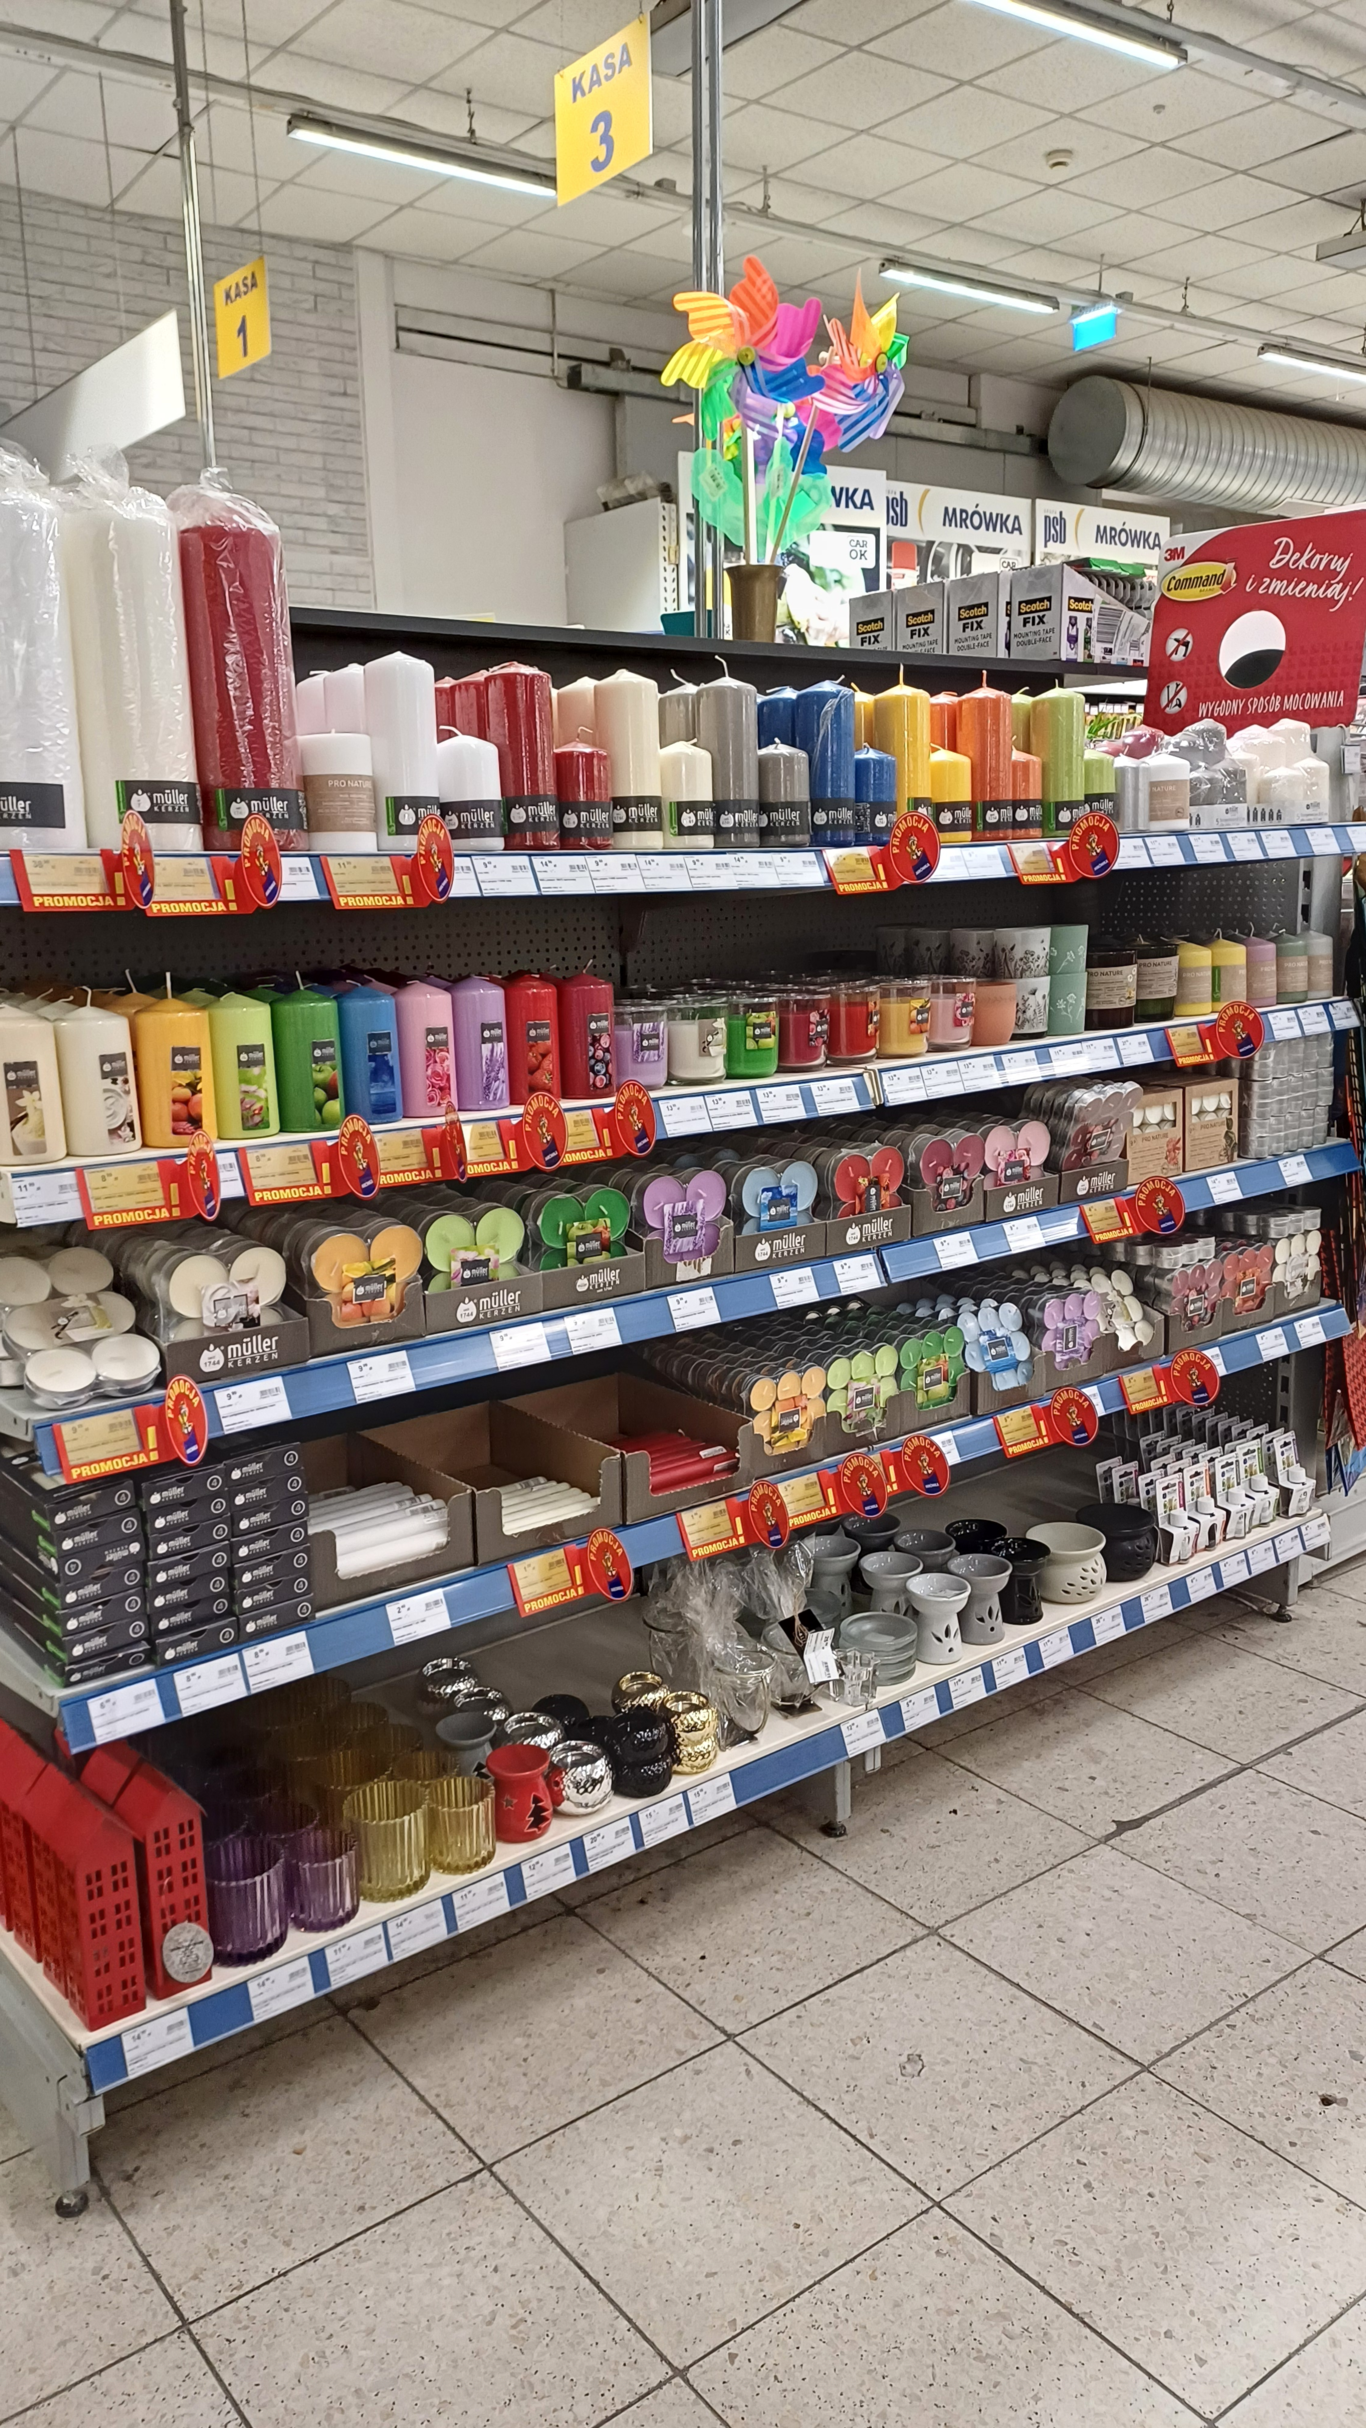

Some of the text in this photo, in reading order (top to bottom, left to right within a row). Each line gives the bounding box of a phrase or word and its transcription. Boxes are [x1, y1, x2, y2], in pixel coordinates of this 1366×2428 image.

[571, 42, 632, 102] KASA
[589, 110, 615, 173] 3
[223, 270, 258, 307] KASA
[236, 314, 248, 358] 1
[942, 503, 1023, 535] MRÓWKA
[1044, 511, 1066, 548] psb
[1095, 522, 1162, 550] MRÓWKA
[849, 539, 868, 549] CAR
[849, 549, 868, 561] OK
[1164, 546, 1185, 562] 3M
[1269, 537, 1353, 583] Dekoruj
[1166, 569, 1227, 592] Command
[1246, 574, 1364, 612] i zmieniaj!
[959, 605, 987, 619] Scotch
[1019, 599, 1051, 614] Scotch
[1069, 598, 1093, 612] Scotch
[857, 620, 883, 634] Scotch
[907, 612, 934, 626] Scotch
[962, 620, 984, 633] FIX
[1022, 614, 1046, 628] FIX
[860, 634, 881, 646] FIX
[910, 627, 931, 639] FIX
[954, 633, 993, 645] MOUNTING TAPE
[1013, 627, 1055, 640] MOUNTING TAPE
[1015, 635, 1052, 648] DOUBLE-FACE
[1198, 690, 1344, 718] WYGODNY SPOSÓB MOCOWANIA
[328, 780, 346, 788] PRO
[0, 796, 32, 813] üller
[153, 789, 189, 806] müller
[250, 795, 289, 813] müller
[1091, 798, 1114, 810] müller
[153, 805, 190, 813] KERZEN
[460, 809, 495, 823] müller
[527, 801, 556, 817] müller
[579, 808, 610, 823] müller
[628, 803, 658, 818] müller
[769, 807, 800, 821] müller
[579, 821, 610, 829] KERZEN
[628, 816, 659, 824] KERZEN
[892, 816, 930, 854] PROMOCJA
[1071, 815, 1110, 851] PROMOCJA
[1218, 1006, 1255, 1033] PROMOCJA
[617, 1083, 648, 1120] PROMOCJA
[525, 1094, 559, 1132] PROMOCJA
[340, 1117, 372, 1155] PROMOCJA
[1151, 1132, 1169, 1141] NATURE
[1090, 1170, 1117, 1188] müller
[1017, 1186, 1044, 1205] müller
[1089, 1181, 1116, 1194] KERZEN
[1138, 1179, 1176, 1207] PROMOCJA
[776, 1205, 790, 1215] müller
[1017, 1199, 1043, 1211] KERZEN
[681, 1220, 696, 1230] müller
[862, 1216, 893, 1234] müller
[772, 1233, 807, 1251] müller
[862, 1230, 893, 1243] KERZEN
[585, 1240, 601, 1251] müller
[772, 1246, 805, 1259] KERZEN
[471, 1267, 489, 1277] müller
[589, 1268, 621, 1285] müller
[364, 1282, 384, 1292] müller
[589, 1279, 620, 1290] KERZEN
[479, 1290, 522, 1311] müller
[479, 1304, 521, 1320] KERZEN
[227, 1334, 279, 1359] müller
[203, 1360, 220, 1368] 1744
[227, 1352, 279, 1369] KERZEN
[1173, 1351, 1211, 1377] PROMOCJA
[1053, 1389, 1089, 1416] PROMOCJA
[904, 1436, 941, 1462] PROMOCJA
[843, 1455, 879, 1484] PROMOCJA
[750, 1482, 781, 1512] PROMOCJA
[589, 1530, 623, 1561] PROMOCJA
